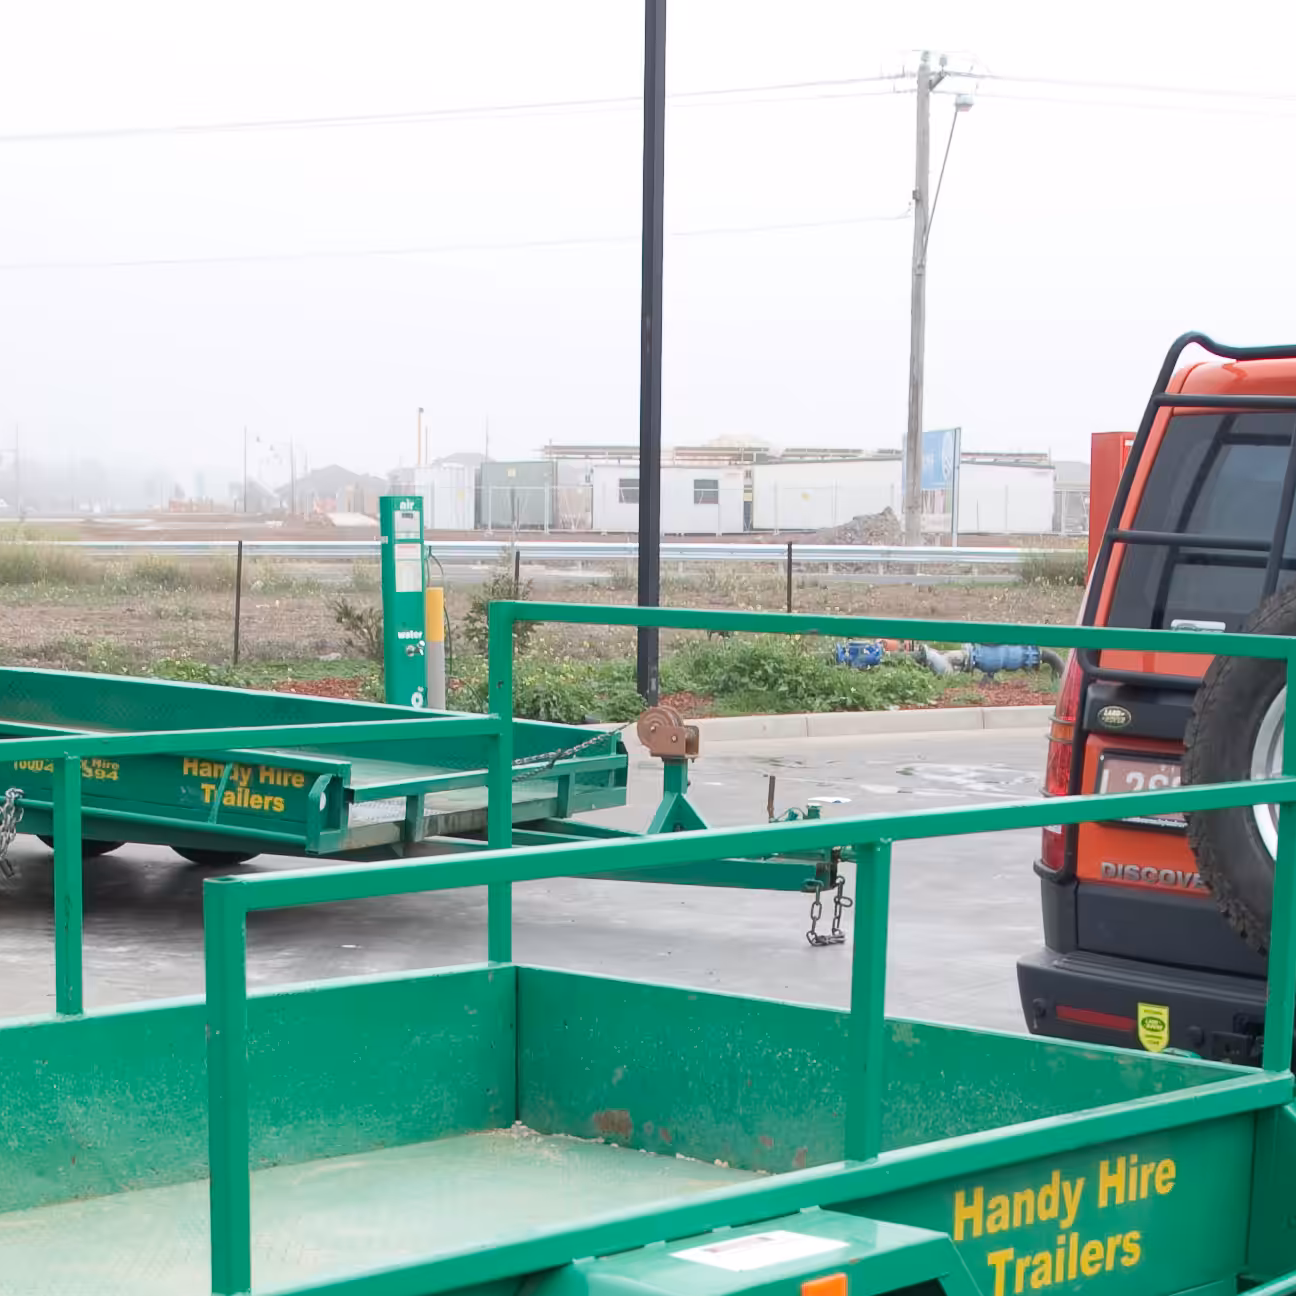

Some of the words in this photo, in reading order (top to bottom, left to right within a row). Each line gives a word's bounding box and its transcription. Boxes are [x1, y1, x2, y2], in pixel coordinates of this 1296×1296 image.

[398, 630, 423, 639] water
[259, 765, 305, 788] Hire
[1101, 861, 1204, 889] DISCOVE
[953, 1170, 1086, 1241] Handy
[1097, 1153, 1177, 1208] Hire
